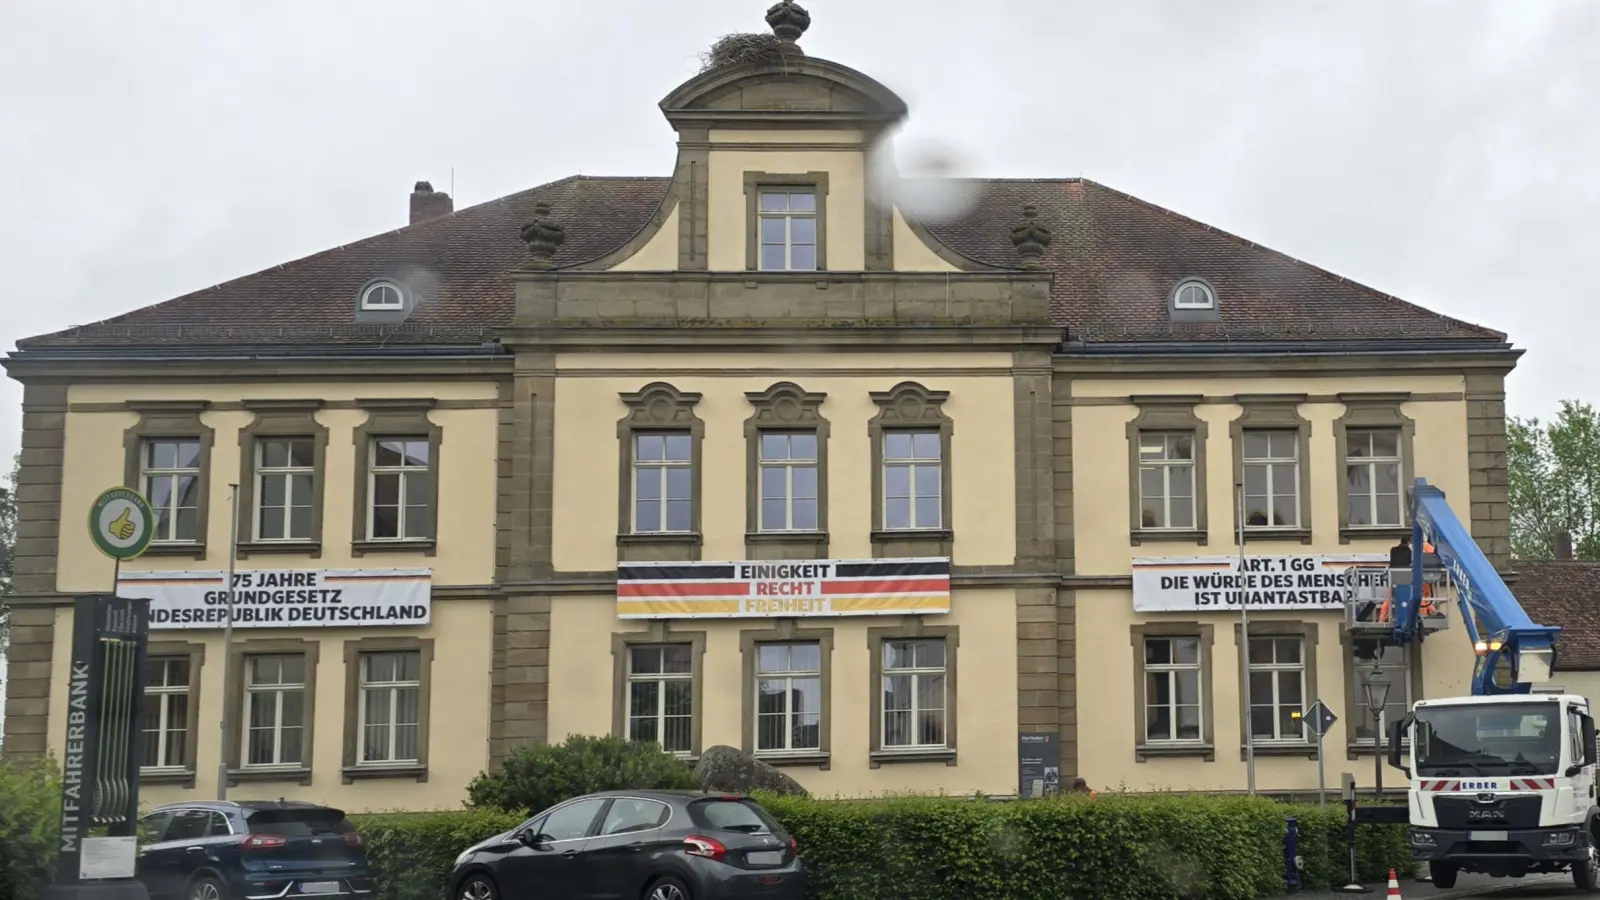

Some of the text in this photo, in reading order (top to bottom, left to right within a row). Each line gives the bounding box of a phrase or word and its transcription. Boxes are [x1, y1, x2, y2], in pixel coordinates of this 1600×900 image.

[741, 564, 830, 579] EINIGKEIT
[1237, 558, 1315, 572] ART. 1 GG
[232, 573, 316, 588] 75 JAHRE
[1161, 576, 1189, 590] DIE
[1193, 572, 1257, 589] WÜRDE
[1261, 575, 1293, 588] DES
[756, 581, 815, 596] RECHT
[204, 589, 342, 605] GRUNDGESETZ
[1195, 592, 1221, 605] IST
[745, 598, 825, 613] FREIHEIT
[148, 607, 284, 623] NDESREPUBLIK
[288, 605, 427, 621] DEUTSCHLAND
